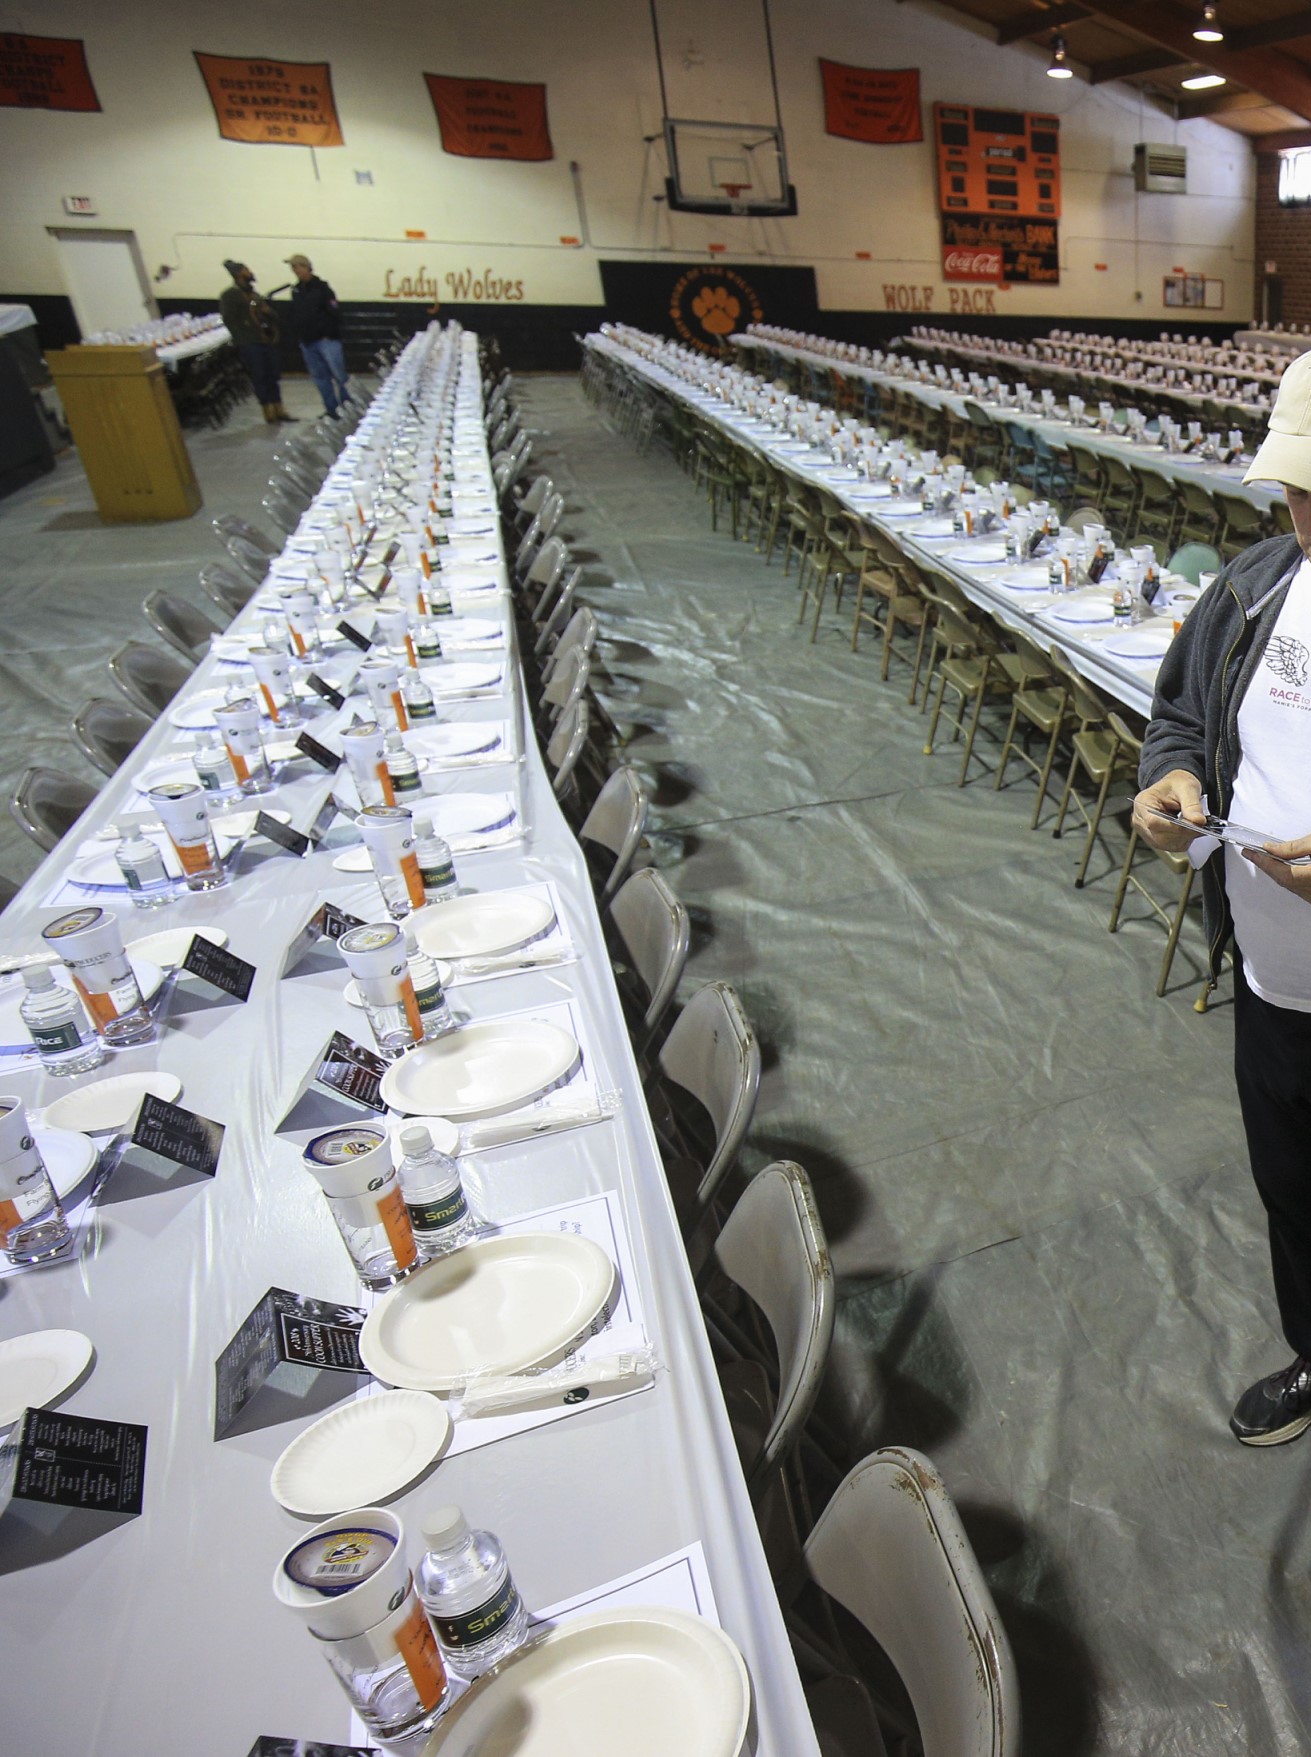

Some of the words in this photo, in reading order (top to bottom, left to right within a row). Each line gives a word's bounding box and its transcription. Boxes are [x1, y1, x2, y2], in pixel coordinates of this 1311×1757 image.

[383, 266, 441, 314] Lady
[446, 268, 524, 300] Wolves
[882, 284, 934, 310] WOLF
[948, 287, 996, 313] PACK
[1269, 687, 1301, 703] RACE
[1301, 696, 1310, 705] to
[310, 1323, 323, 1347] SUPPER
[314, 1345, 326, 1364] COON
